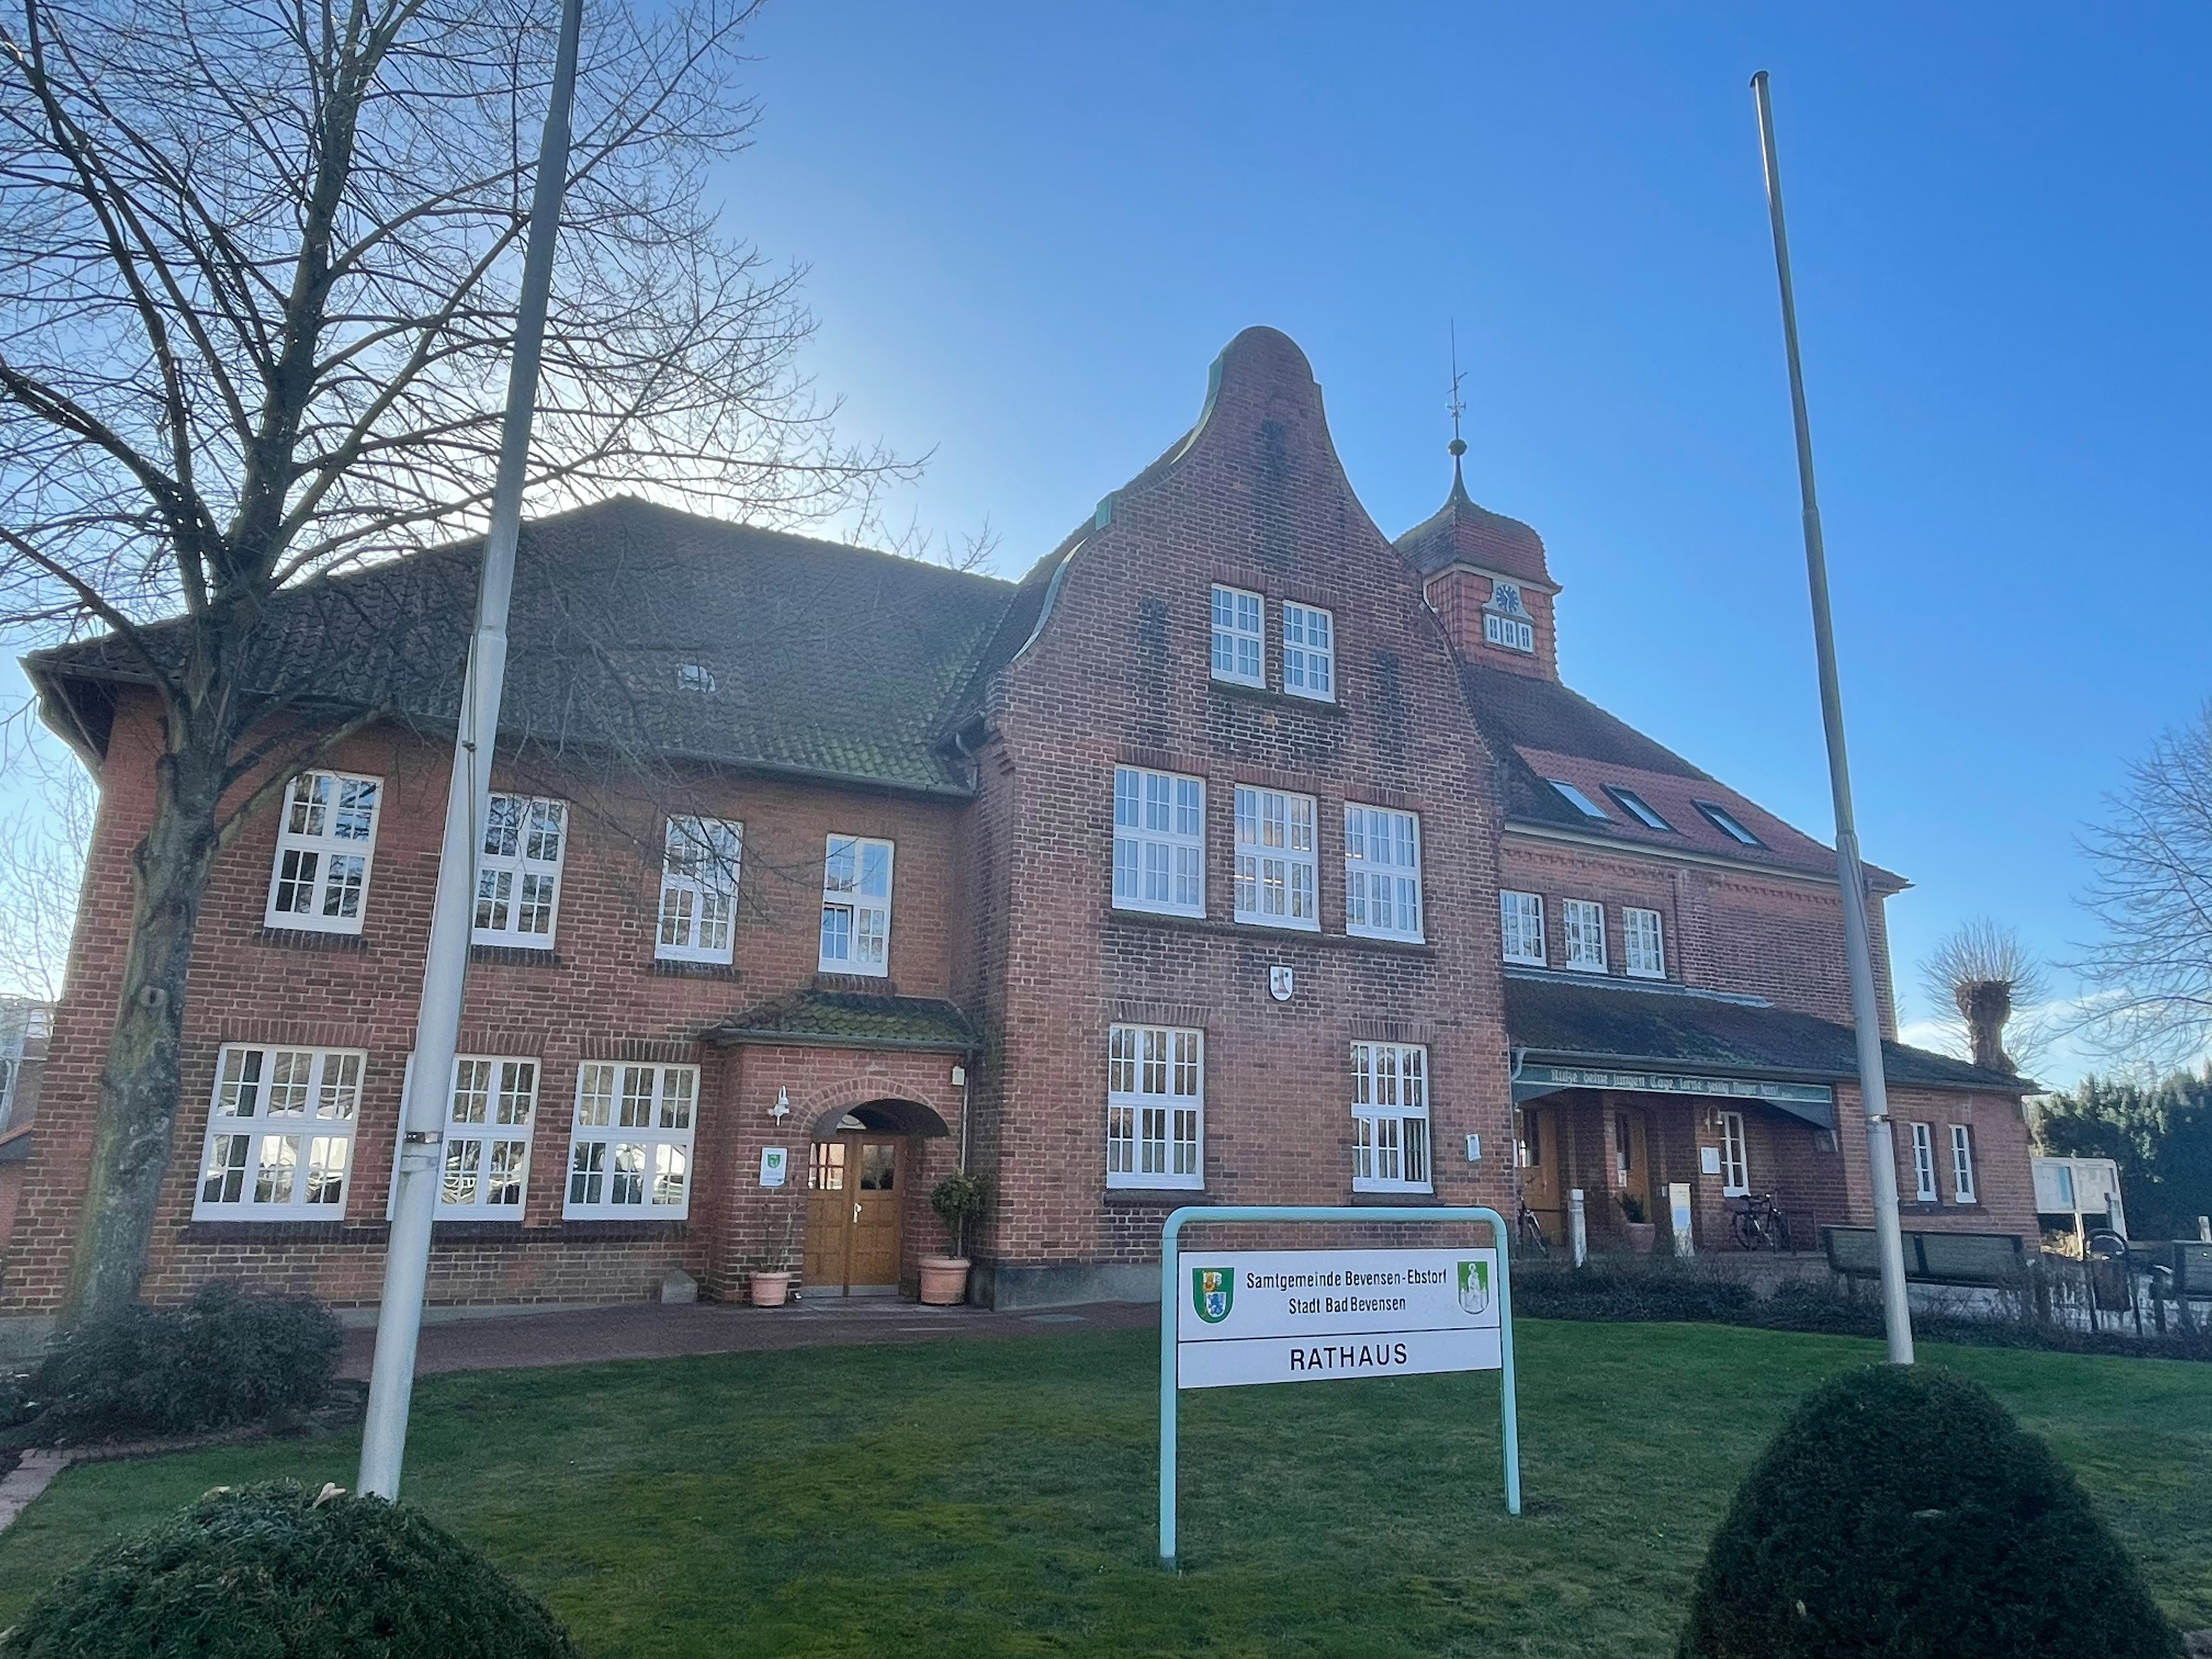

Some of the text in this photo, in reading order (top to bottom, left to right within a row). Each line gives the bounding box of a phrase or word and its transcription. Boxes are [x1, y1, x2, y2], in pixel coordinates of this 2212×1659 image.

[1246, 1268, 1447, 1291] Samtgemeinde Bevensen-Ebstorf
[1289, 1296, 1406, 1314] Stadt Bad Bevensen
[1290, 1343, 1407, 1370] RATHAUS
